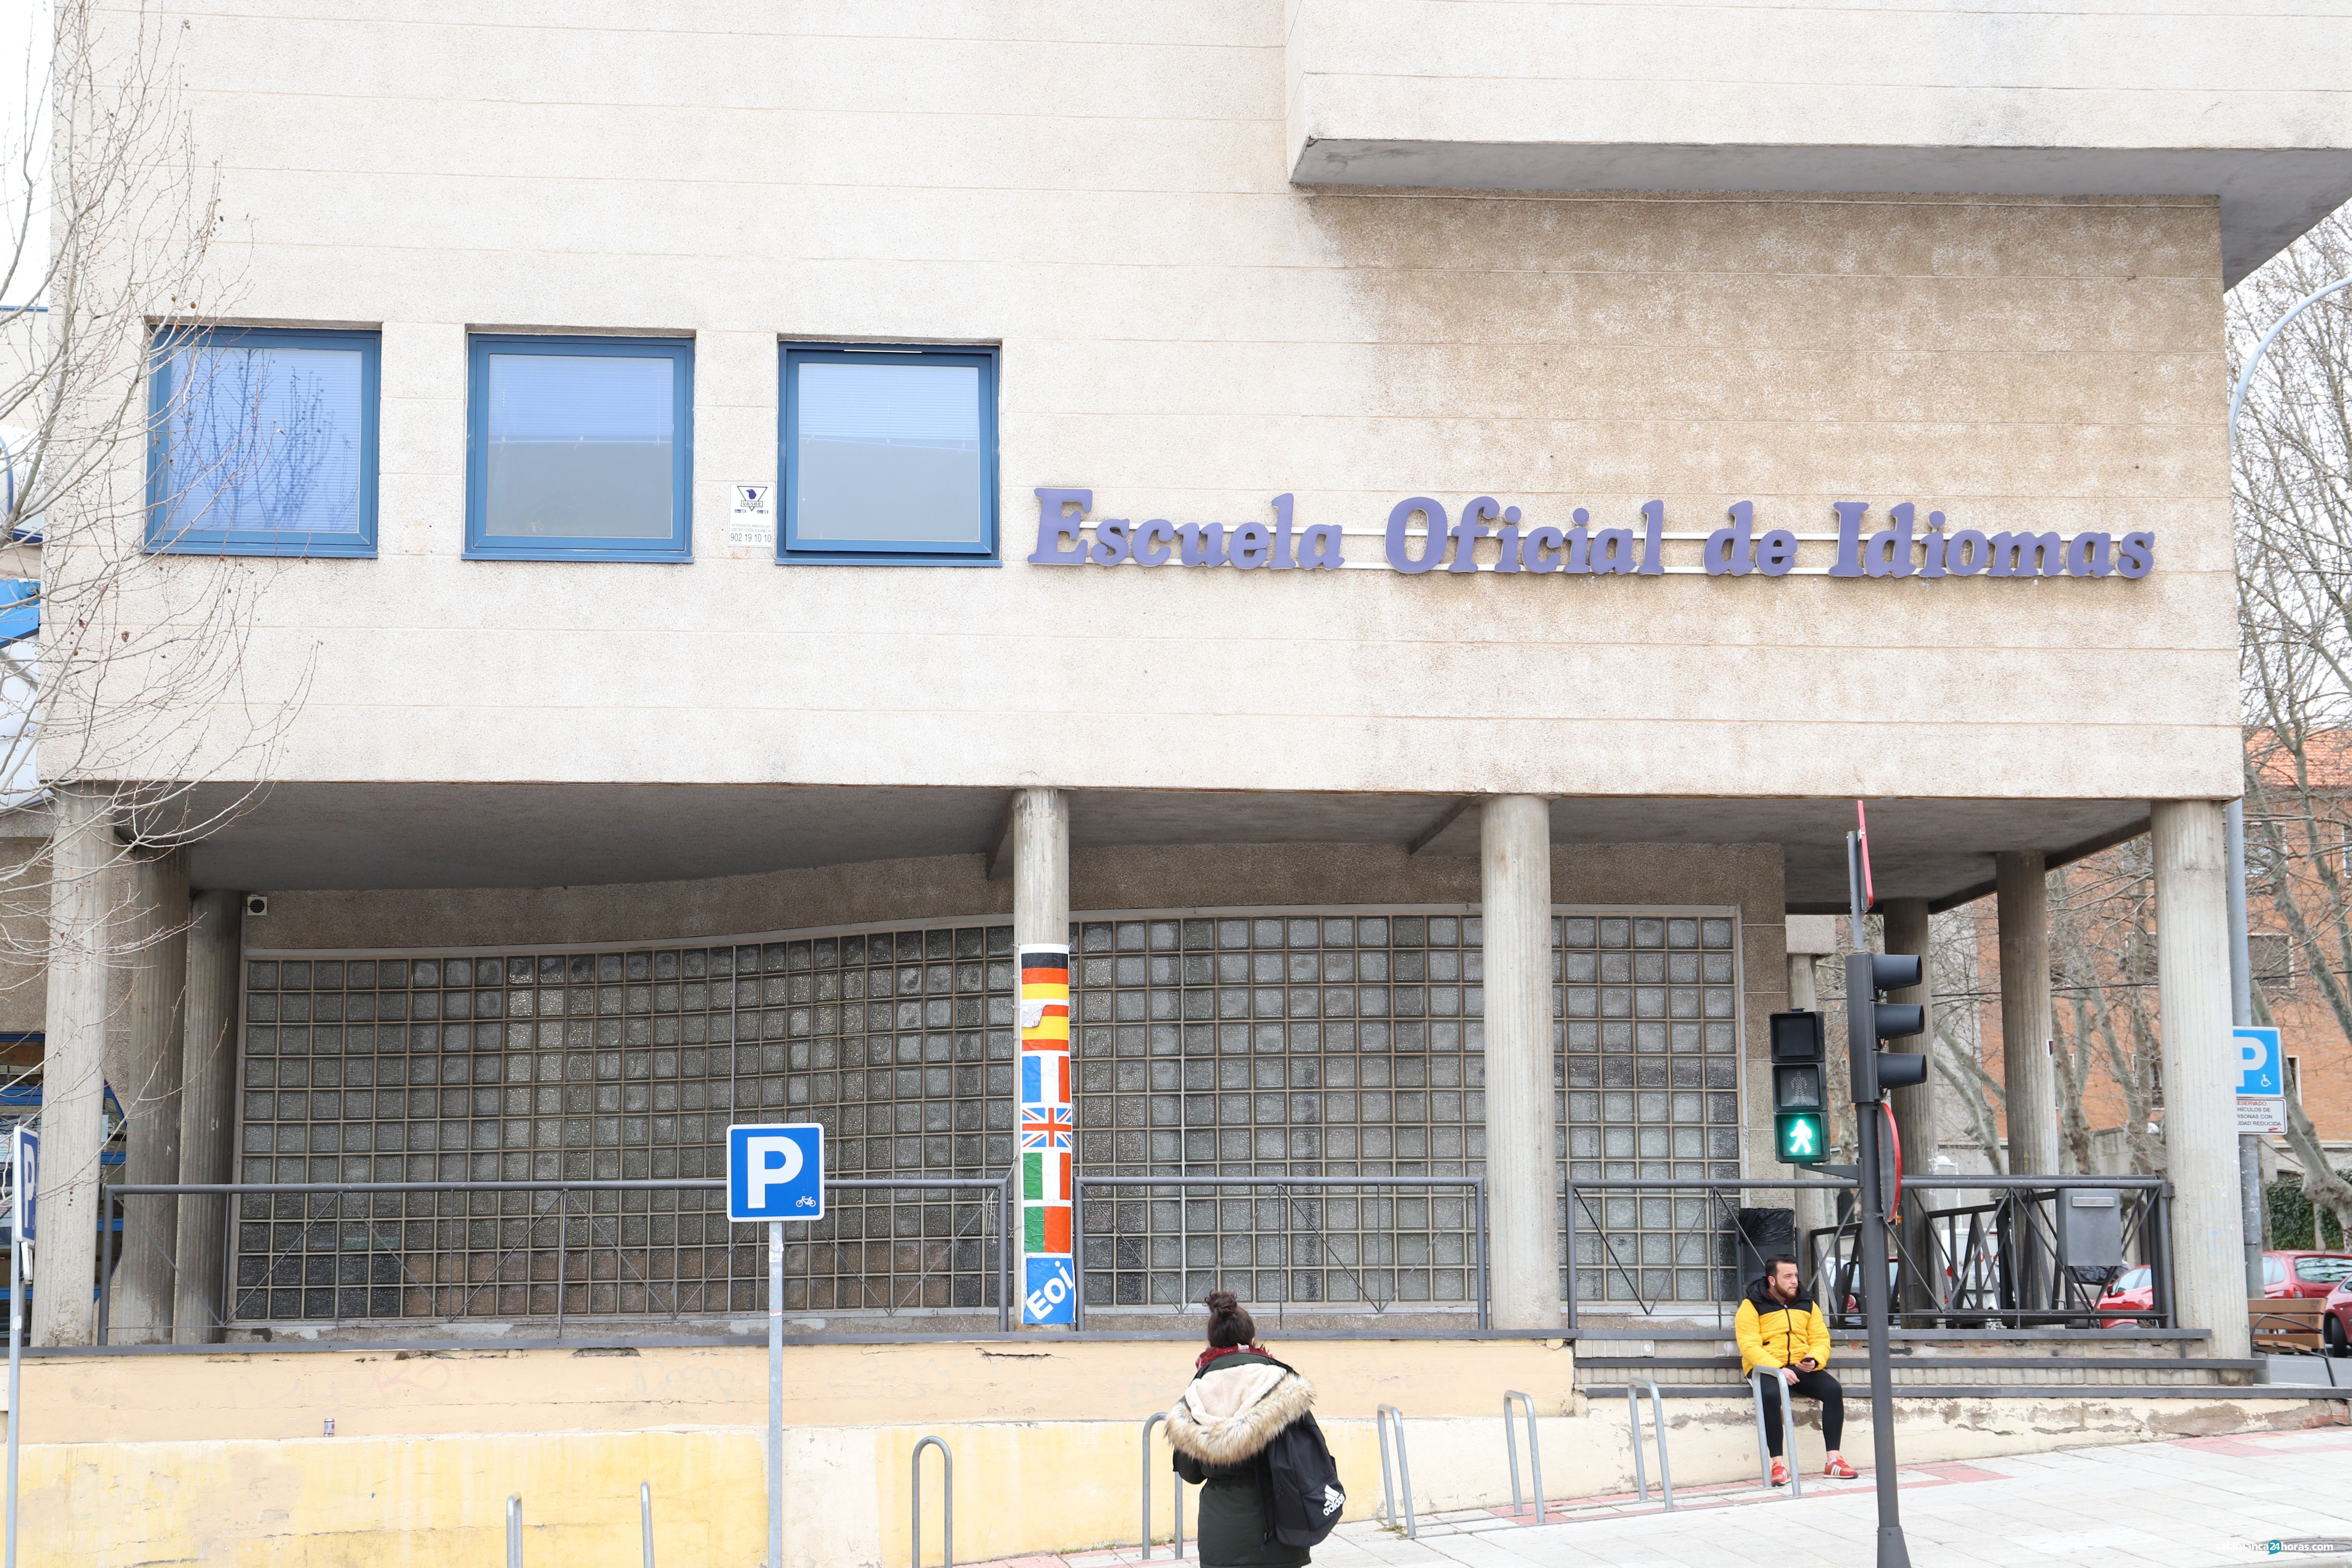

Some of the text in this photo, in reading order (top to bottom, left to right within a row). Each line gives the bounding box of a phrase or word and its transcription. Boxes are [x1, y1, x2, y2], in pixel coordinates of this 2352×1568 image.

[730, 533, 742, 541] 902
[754, 534, 761, 542] 10
[764, 534, 771, 542] 10
[1027, 488, 2155, 578] Escuela Oficial de Idiomas
[2233, 1037, 2267, 1087] P
[24, 1143, 35, 1228] P
[747, 1136, 803, 1209] P
[1323, 1493, 1345, 1516] adidas
